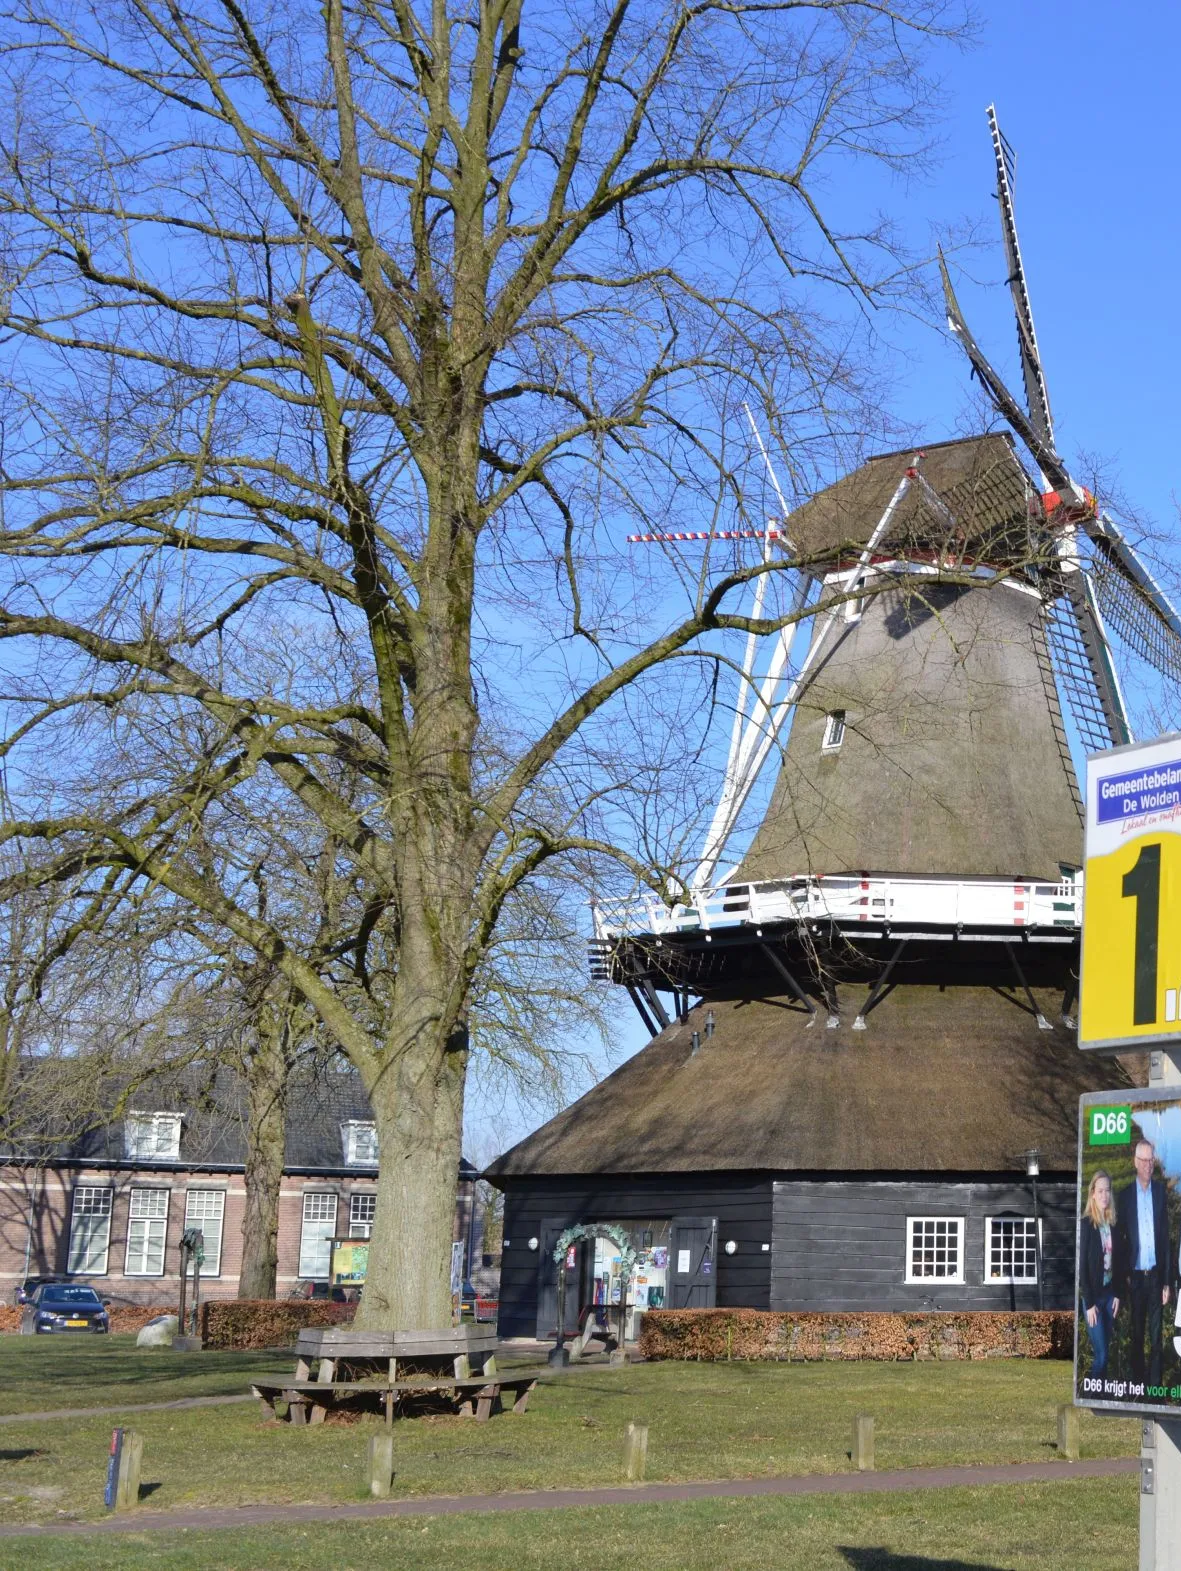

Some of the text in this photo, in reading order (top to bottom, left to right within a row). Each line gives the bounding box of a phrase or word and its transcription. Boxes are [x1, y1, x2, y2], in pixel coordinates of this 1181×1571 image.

[1123, 791, 1180, 813] De Wolden
[1122, 843, 1162, 1026] 1
[1093, 1112, 1127, 1134] D66
[1083, 1378, 1102, 1392] D66
[1104, 1379, 1127, 1397] krijgt
[1129, 1381, 1145, 1396] het
[1146, 1386, 1168, 1397] voor
